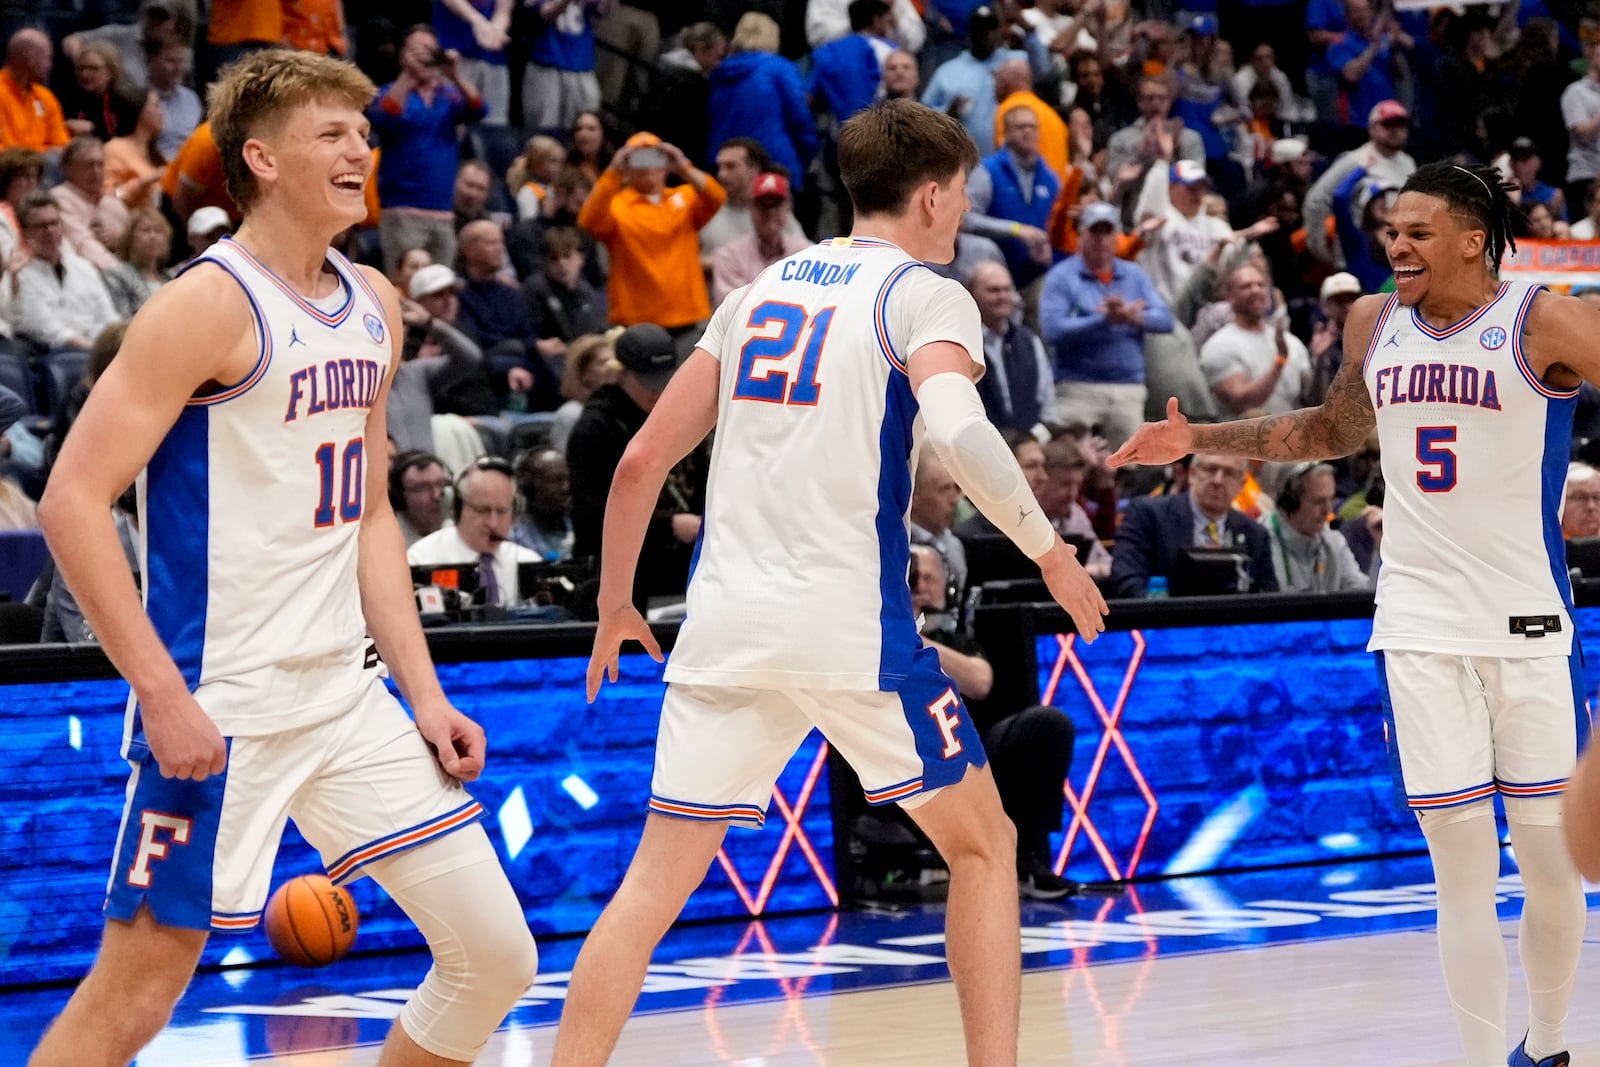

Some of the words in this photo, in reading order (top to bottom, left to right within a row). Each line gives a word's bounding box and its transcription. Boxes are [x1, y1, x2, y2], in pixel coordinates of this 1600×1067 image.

[731, 299, 837, 406] 21
[1481, 328, 1505, 349] SEC
[1375, 363, 1502, 411] FLORIDA
[314, 437, 363, 529] 10
[1415, 425, 1457, 493] 5
[926, 685, 963, 760] F
[126, 809, 193, 889] F
